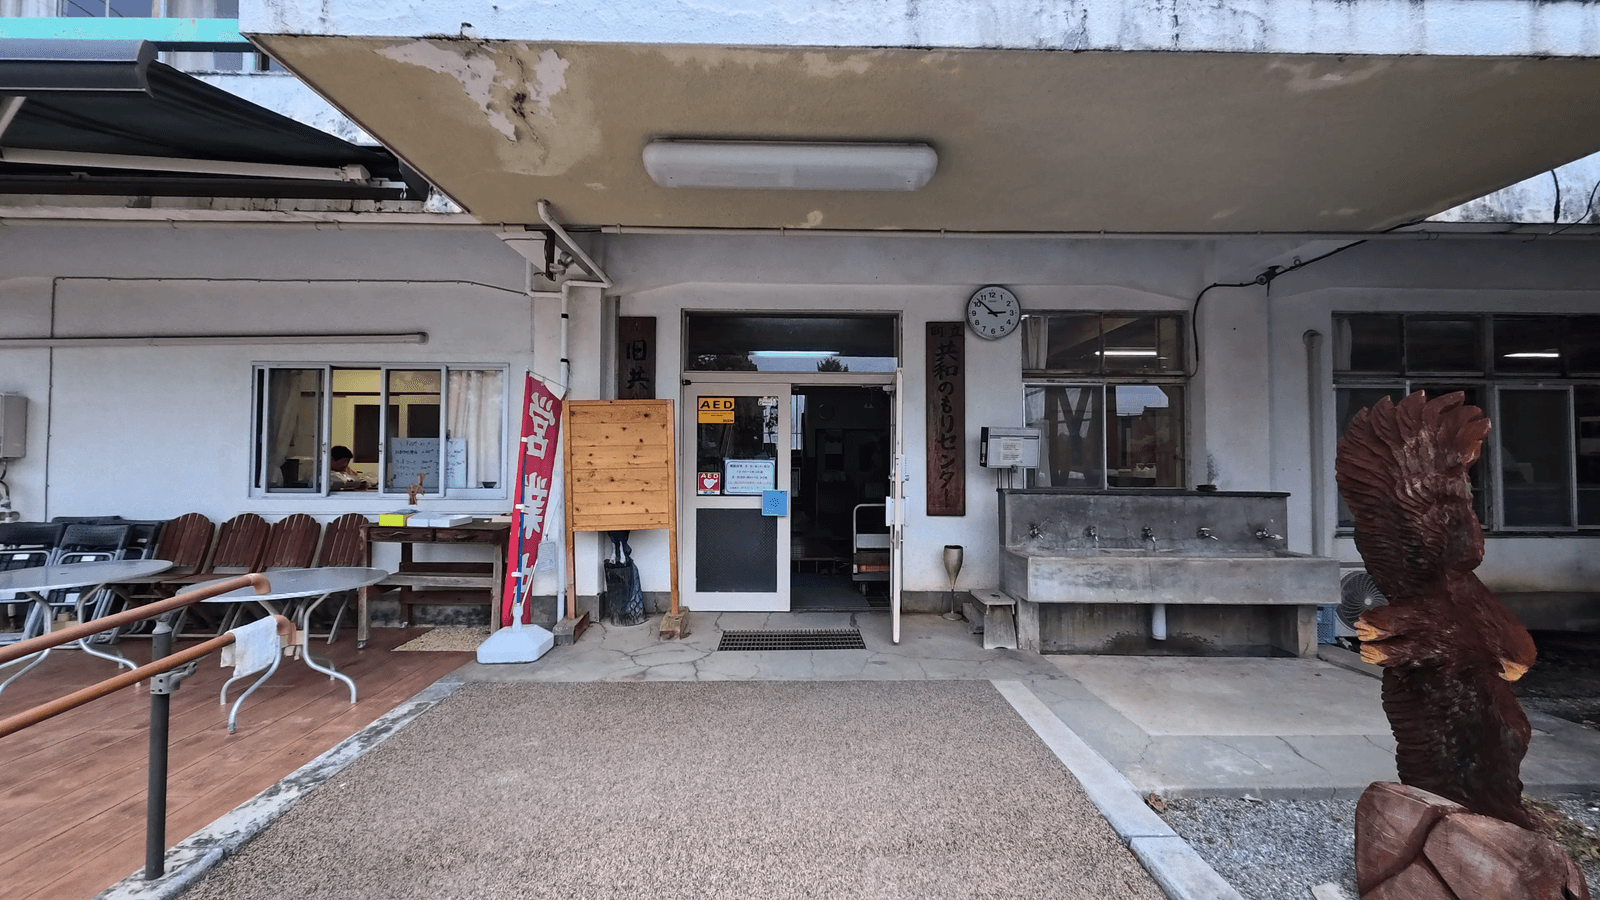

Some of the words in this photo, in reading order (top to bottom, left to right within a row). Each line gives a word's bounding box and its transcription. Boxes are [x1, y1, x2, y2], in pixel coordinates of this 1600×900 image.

[931, 325, 964, 338] 町立
[626, 339, 650, 398] 旧共
[700, 400, 732, 409] AED
[933, 339, 959, 508] 共和のもりセンター
